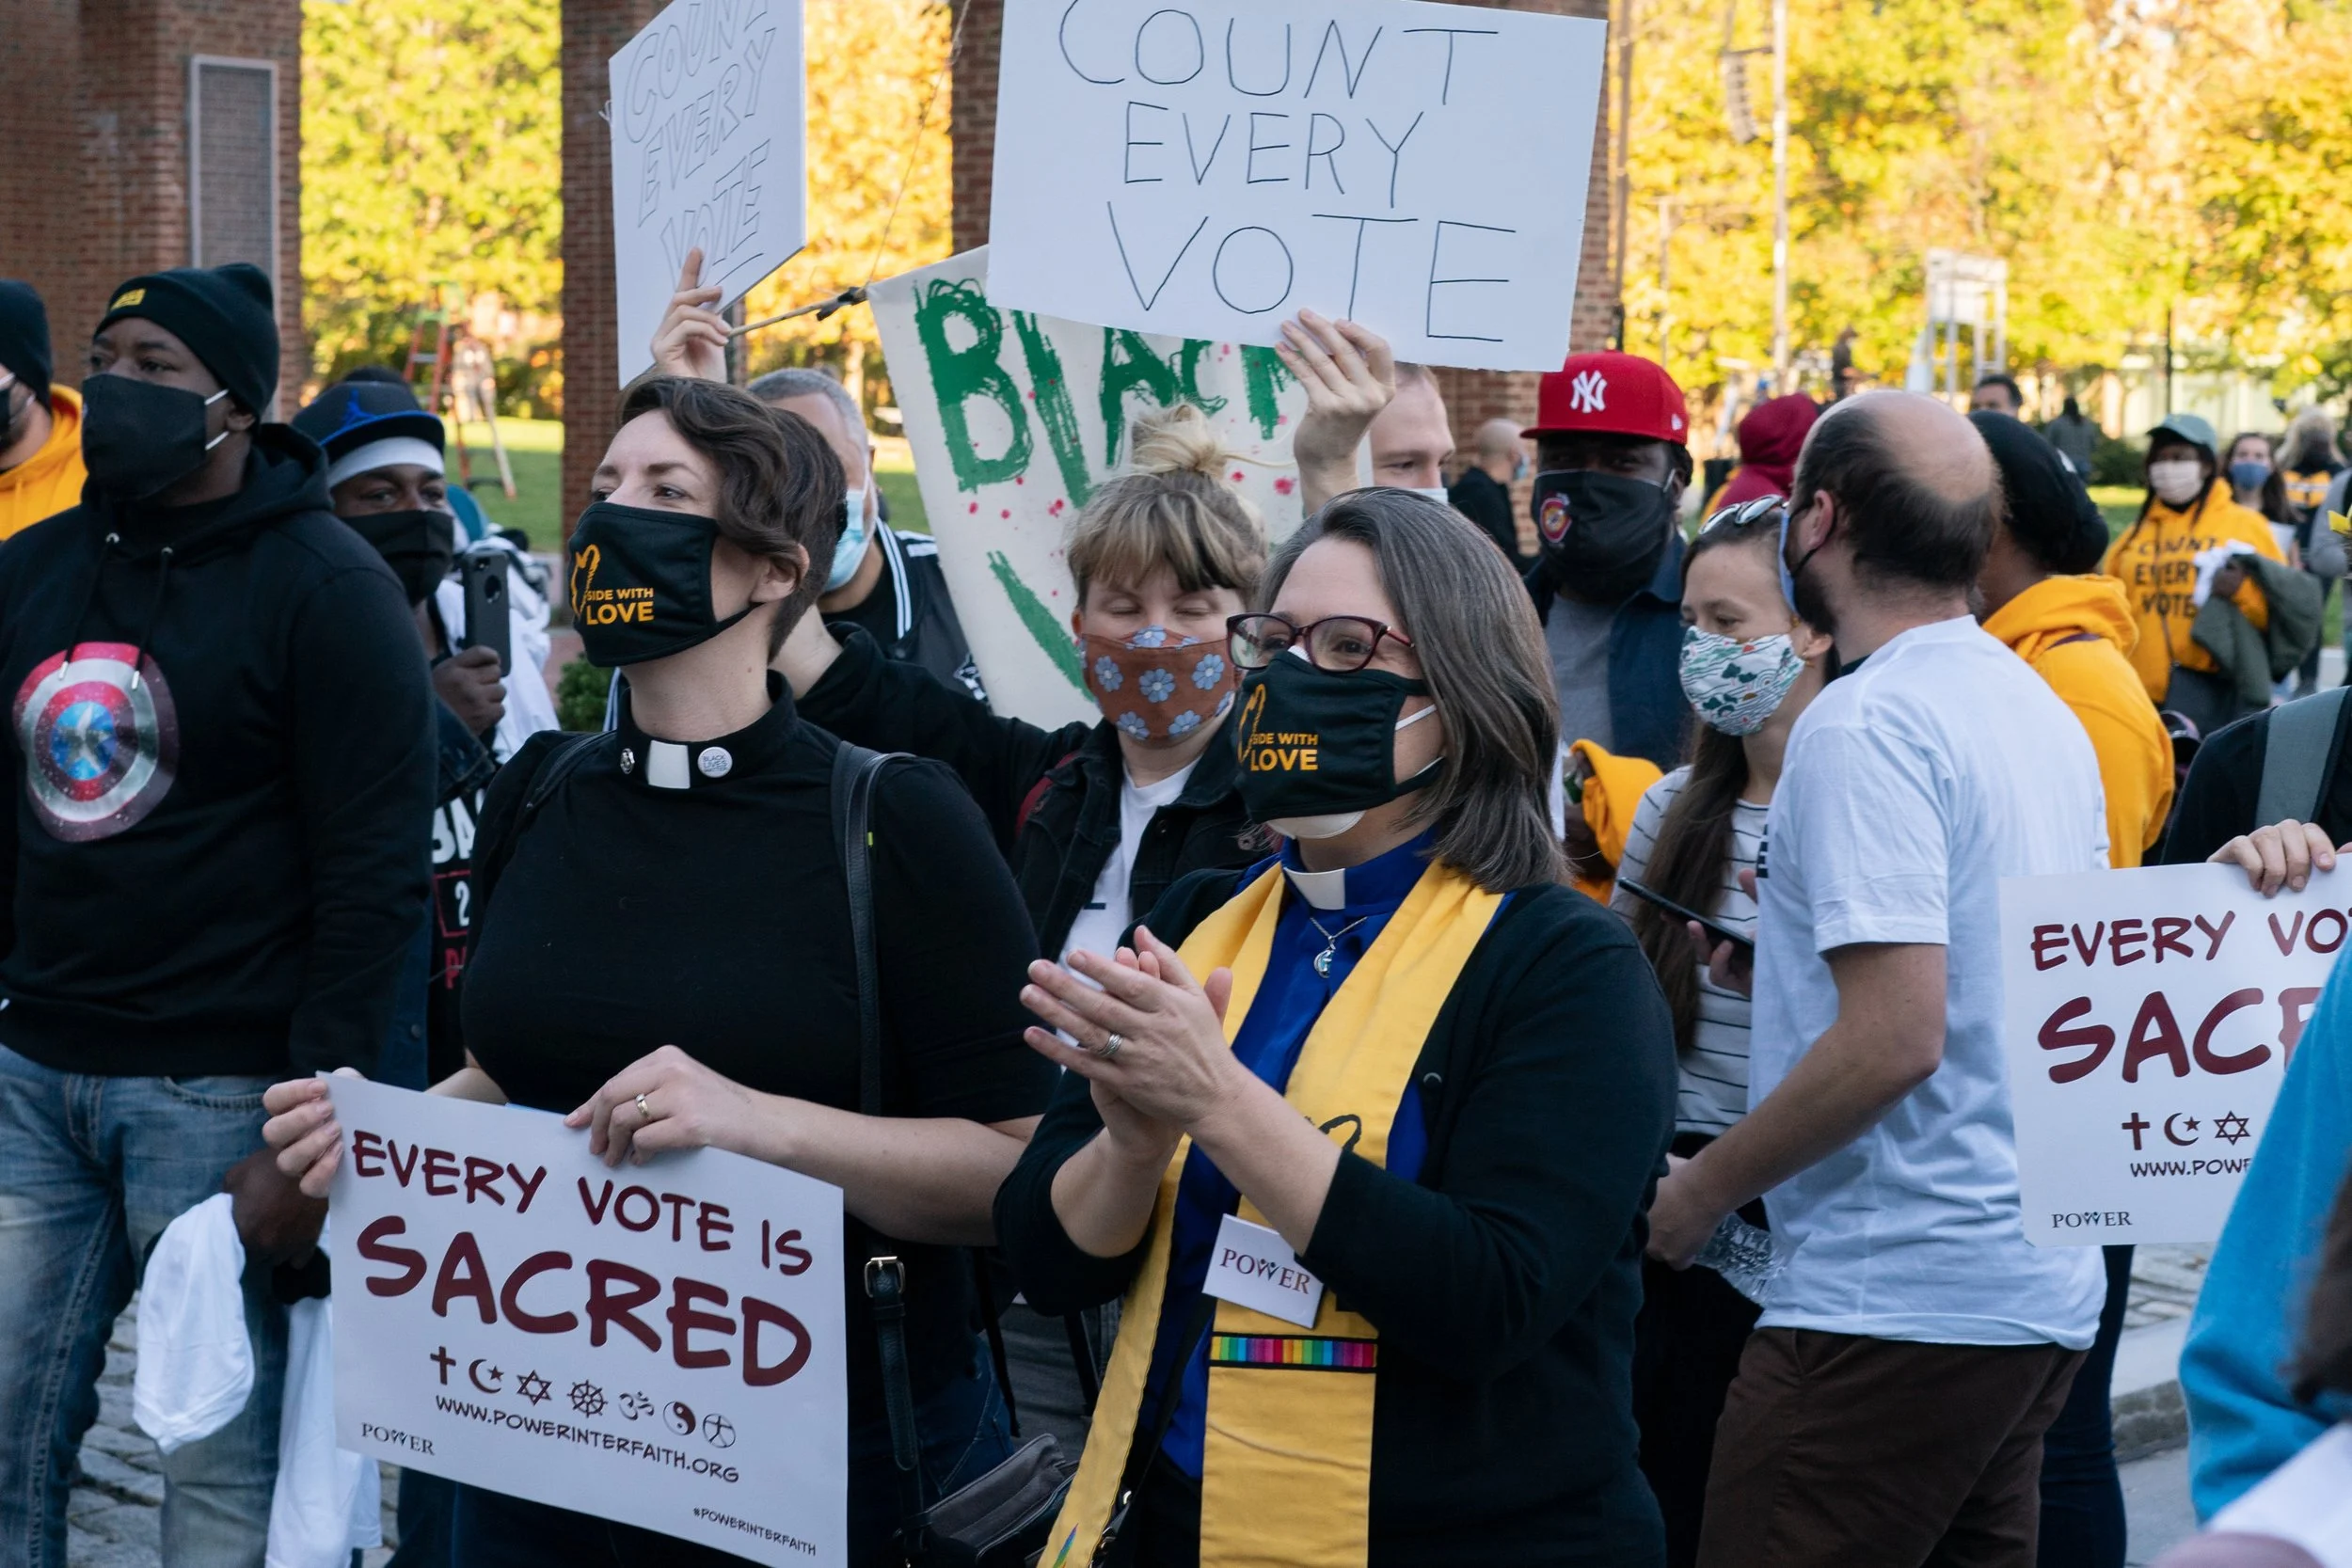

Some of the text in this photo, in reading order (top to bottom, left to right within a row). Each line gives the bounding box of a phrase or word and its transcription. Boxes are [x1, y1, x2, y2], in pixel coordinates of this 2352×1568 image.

[1059, 0, 1499, 105] COUNT
[638, 27, 776, 228] EVERY
[1125, 101, 1423, 208] EVERY
[660, 138, 771, 292] VOTE
[1107, 201, 1517, 341] VOTE
[586, 588, 654, 601] SIDE WITH
[587, 601, 655, 626] LOVE
[1250, 748, 1319, 771] LOVE
[1278, 733, 1319, 746] WITH
[2031, 908, 2352, 971] EVERY VO
[352, 1130, 813, 1276] EVERY VOTE IS
[2052, 1211, 2134, 1228] POWER
[357, 1215, 813, 1387] SACRED
[1219, 1246, 1311, 1295] POWER
[361, 1421, 436, 1456] POWER
[435, 1394, 739, 1483] WWW.POWERINTERFAITH.ORG
[692, 1506, 817, 1557] #POWERINTERFAITH
